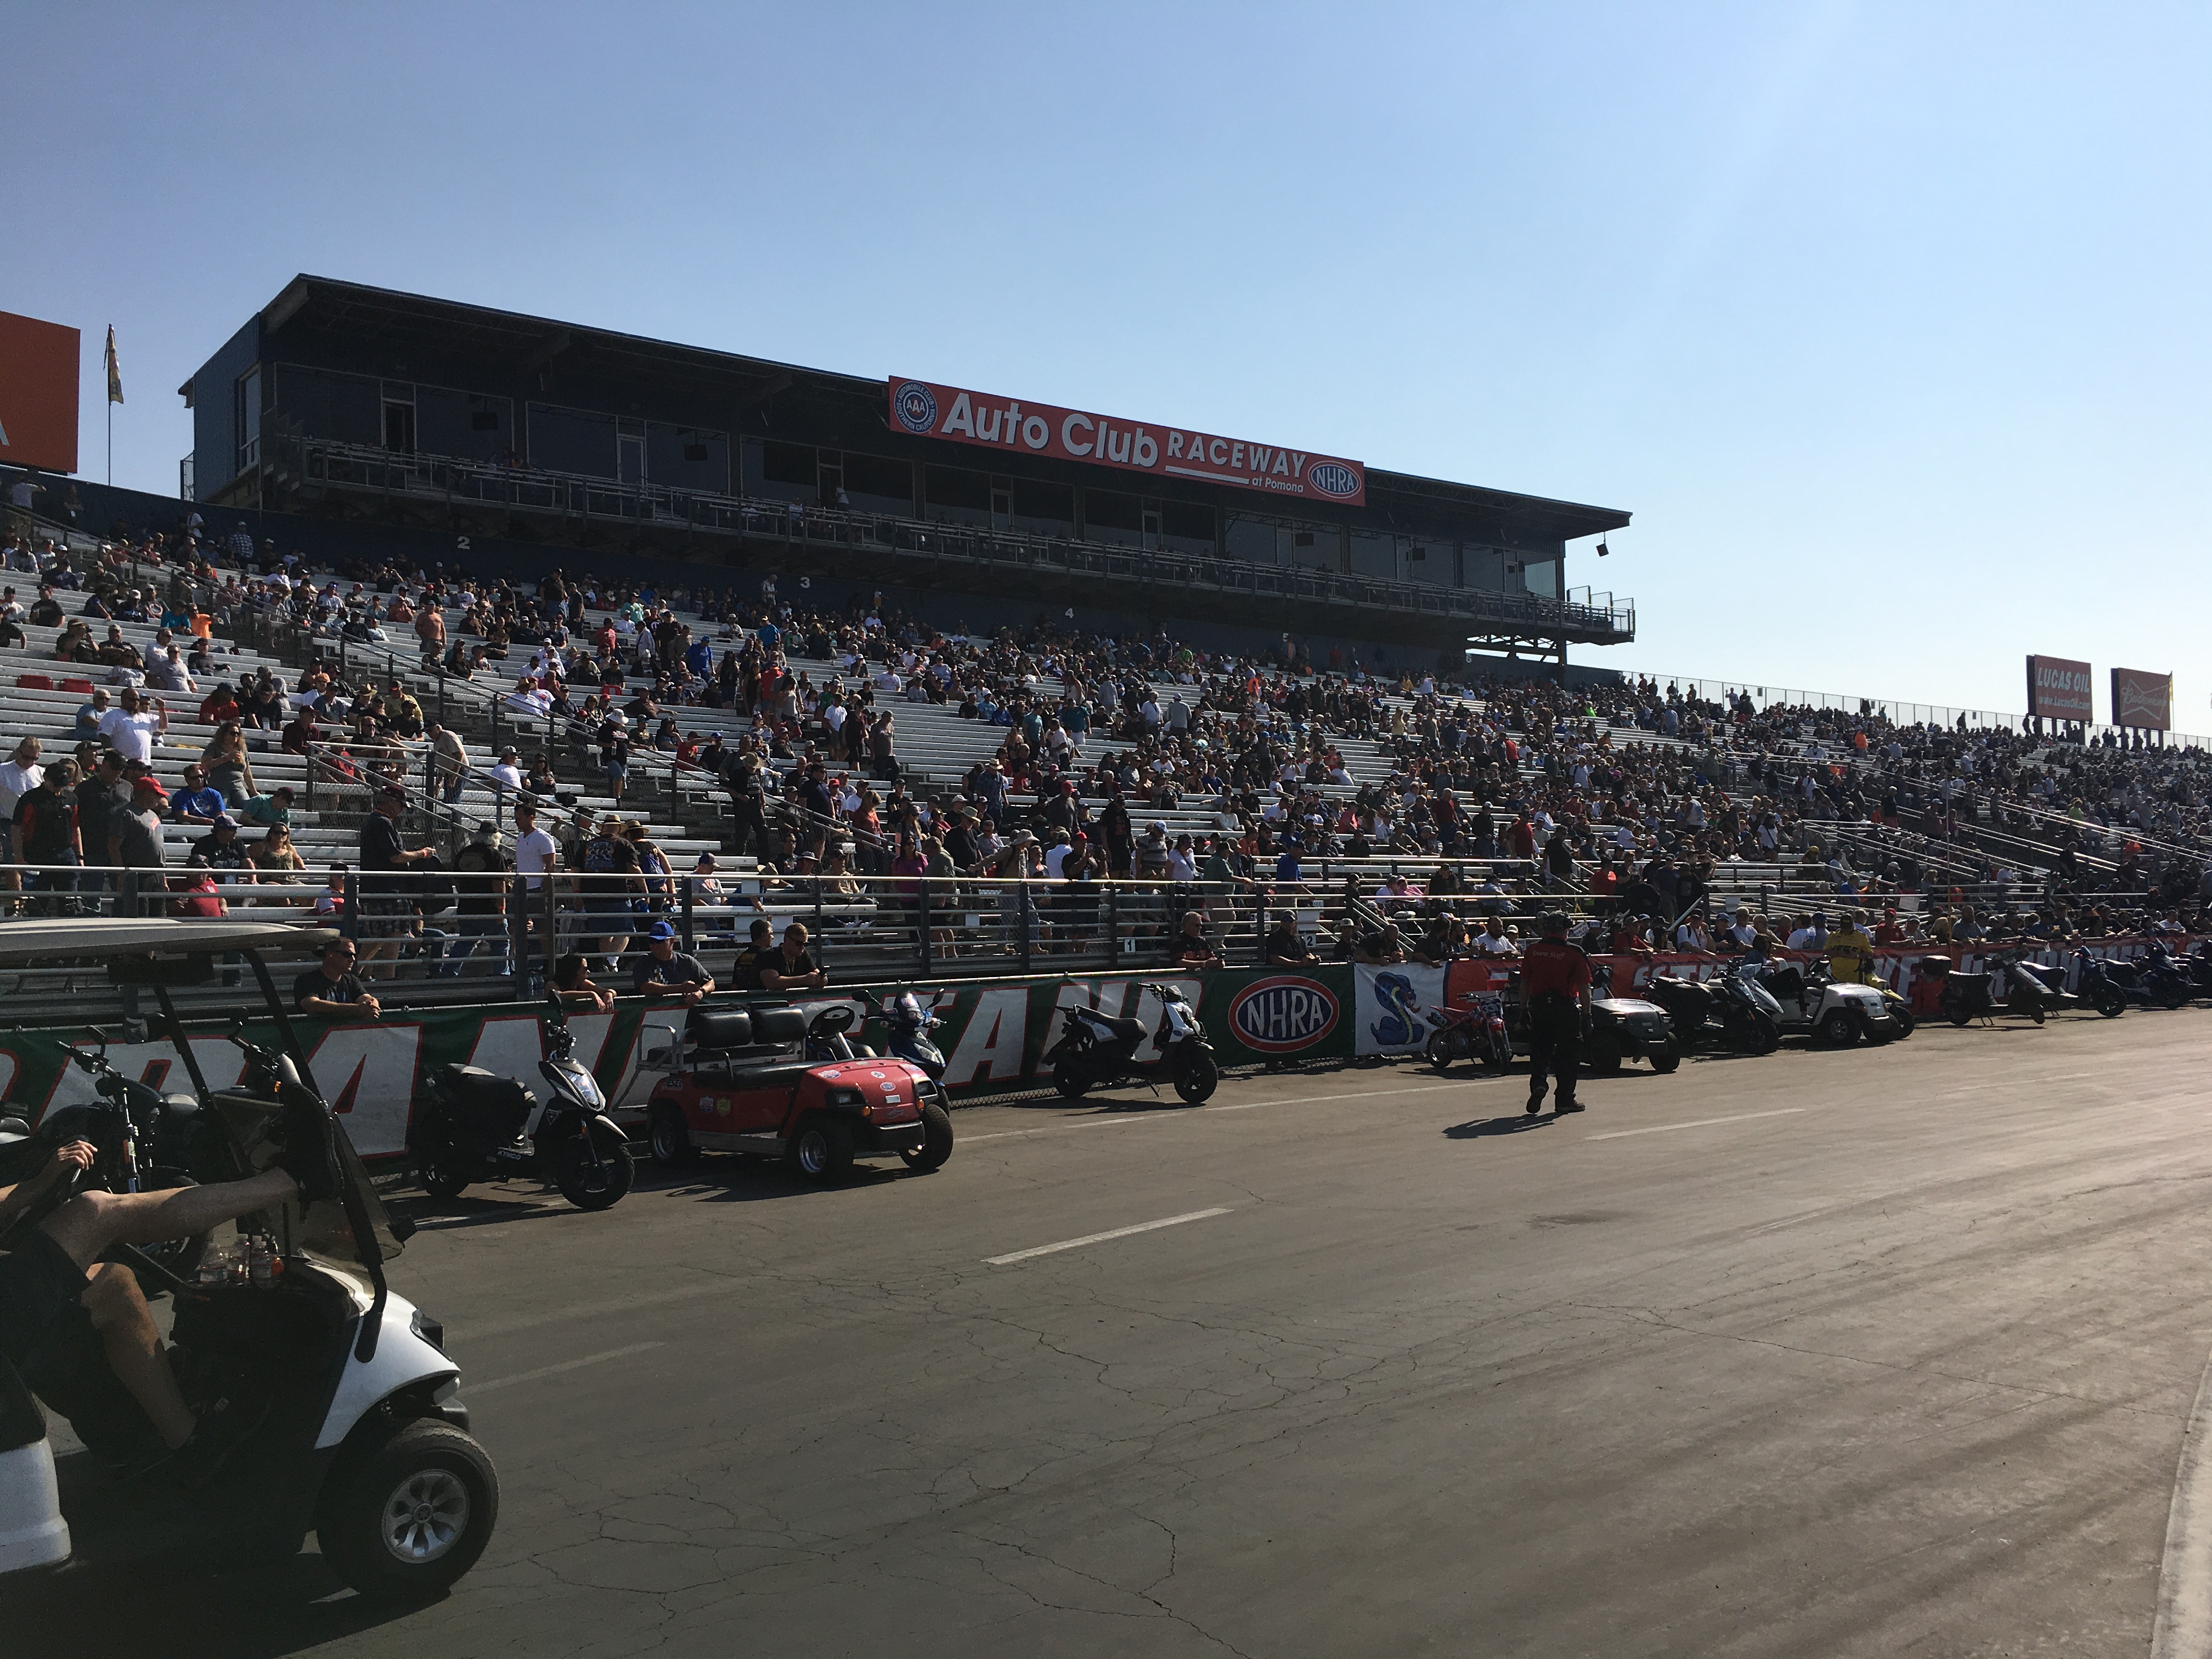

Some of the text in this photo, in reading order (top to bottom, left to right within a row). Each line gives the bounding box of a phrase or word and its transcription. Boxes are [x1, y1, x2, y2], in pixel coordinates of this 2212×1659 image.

[898, 384, 934, 405] AUTOMOBILE CLUB
[906, 399, 925, 413] AAA
[896, 402, 935, 430] SOUTHERN CALIFORNIA
[941, 392, 1158, 467] Auto Club
[1167, 431, 1306, 477] RACEWAY
[1252, 476, 1304, 493] at Pomona
[1316, 467, 1355, 492] NHRA
[457, 535, 470, 550] 2
[800, 576, 811, 589] 3
[1065, 608, 1074, 618] 4
[1282, 633, 1289, 642] 5
[1465, 654, 1472, 663] 6
[2036, 667, 2090, 693] LUCAS OIL
[1127, 939, 1132, 952] 1
[1307, 935, 1313, 946] 2
[1549, 952, 1566, 960] Staff
[1247, 990, 1324, 1038] NHRA
[496, 1150, 522, 1160] KYMCO
